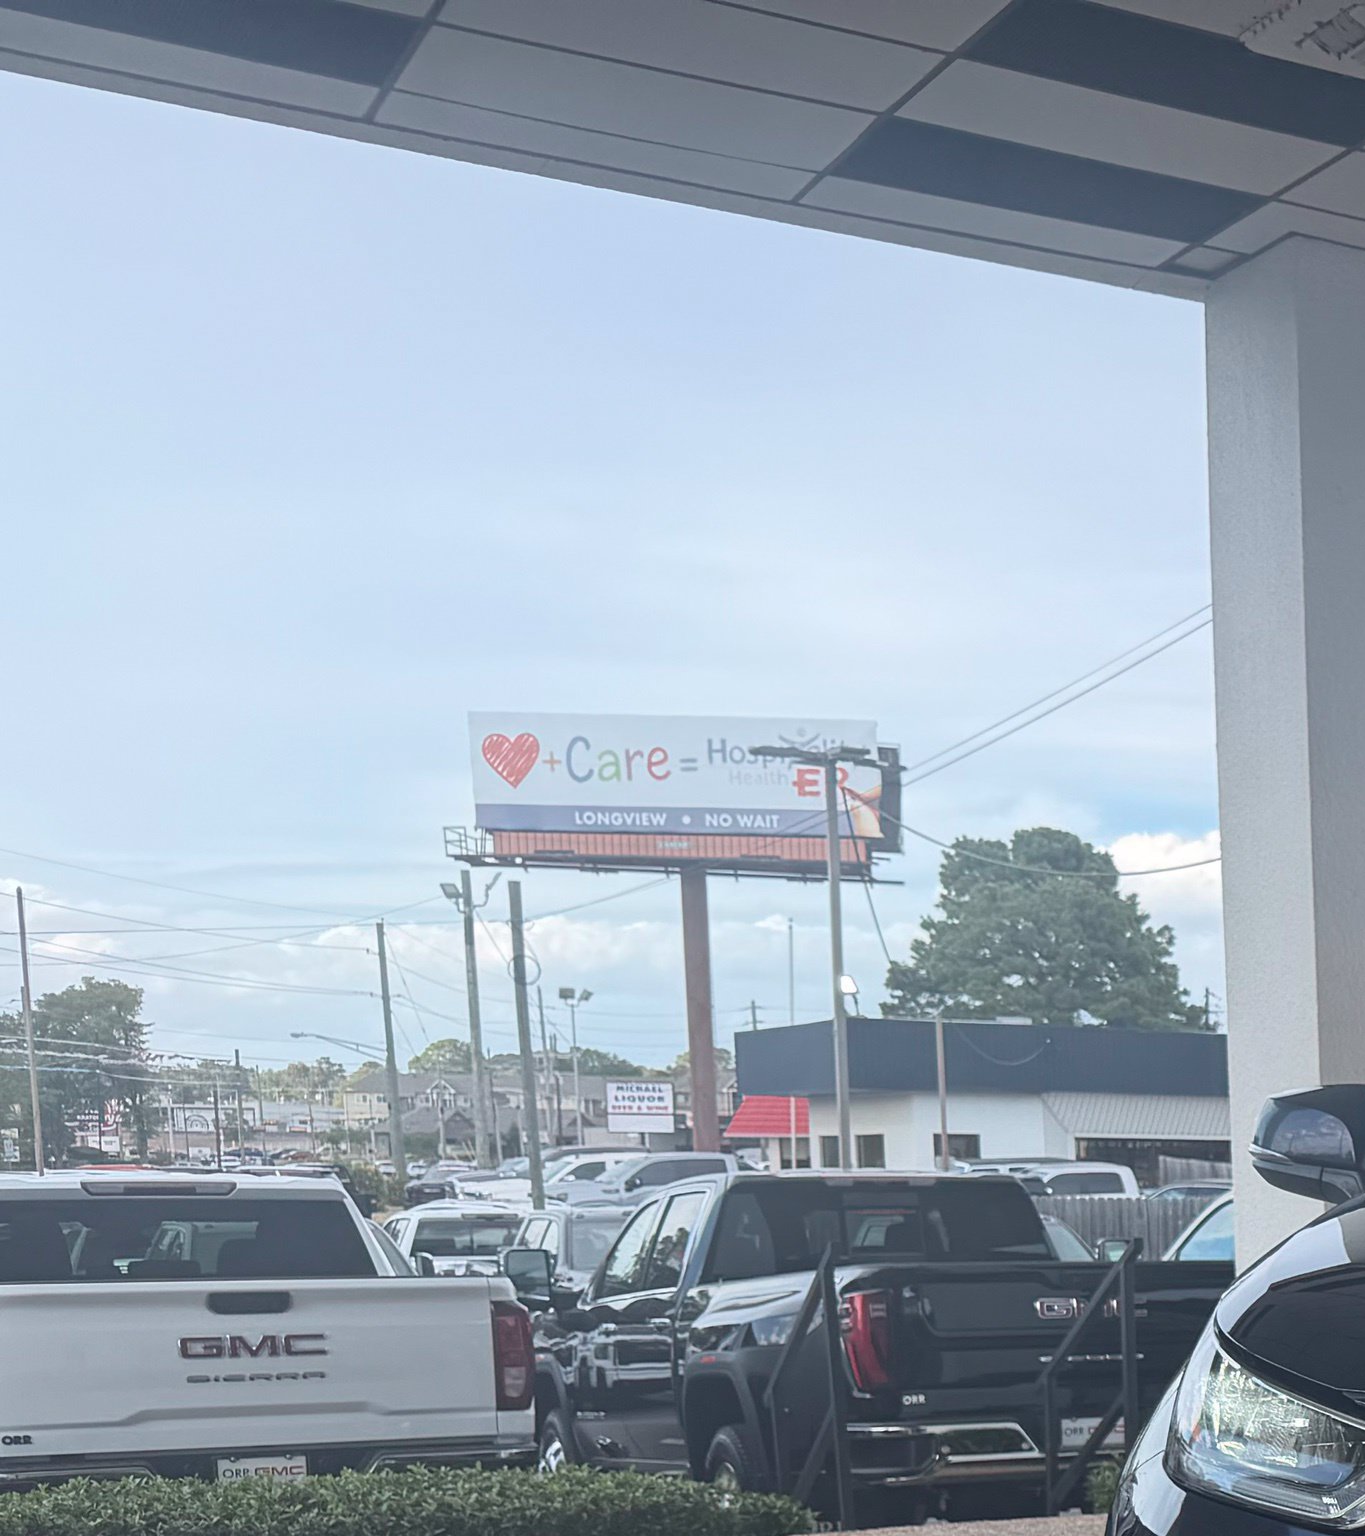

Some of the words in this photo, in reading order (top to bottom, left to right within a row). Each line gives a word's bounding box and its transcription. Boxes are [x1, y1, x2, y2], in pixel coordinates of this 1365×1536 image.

[566, 736, 671, 783] Care
[575, 811, 667, 826] LONGVIEW
[705, 813, 732, 828] NO
[736, 815, 780, 829] WAIT
[614, 1095, 665, 1103] LIQUOR
[177, 1334, 328, 1359] GMC
[186, 1371, 326, 1383] SIERRA
[902, 1394, 926, 1406] ORR
[1, 1434, 33, 1446] ORR
